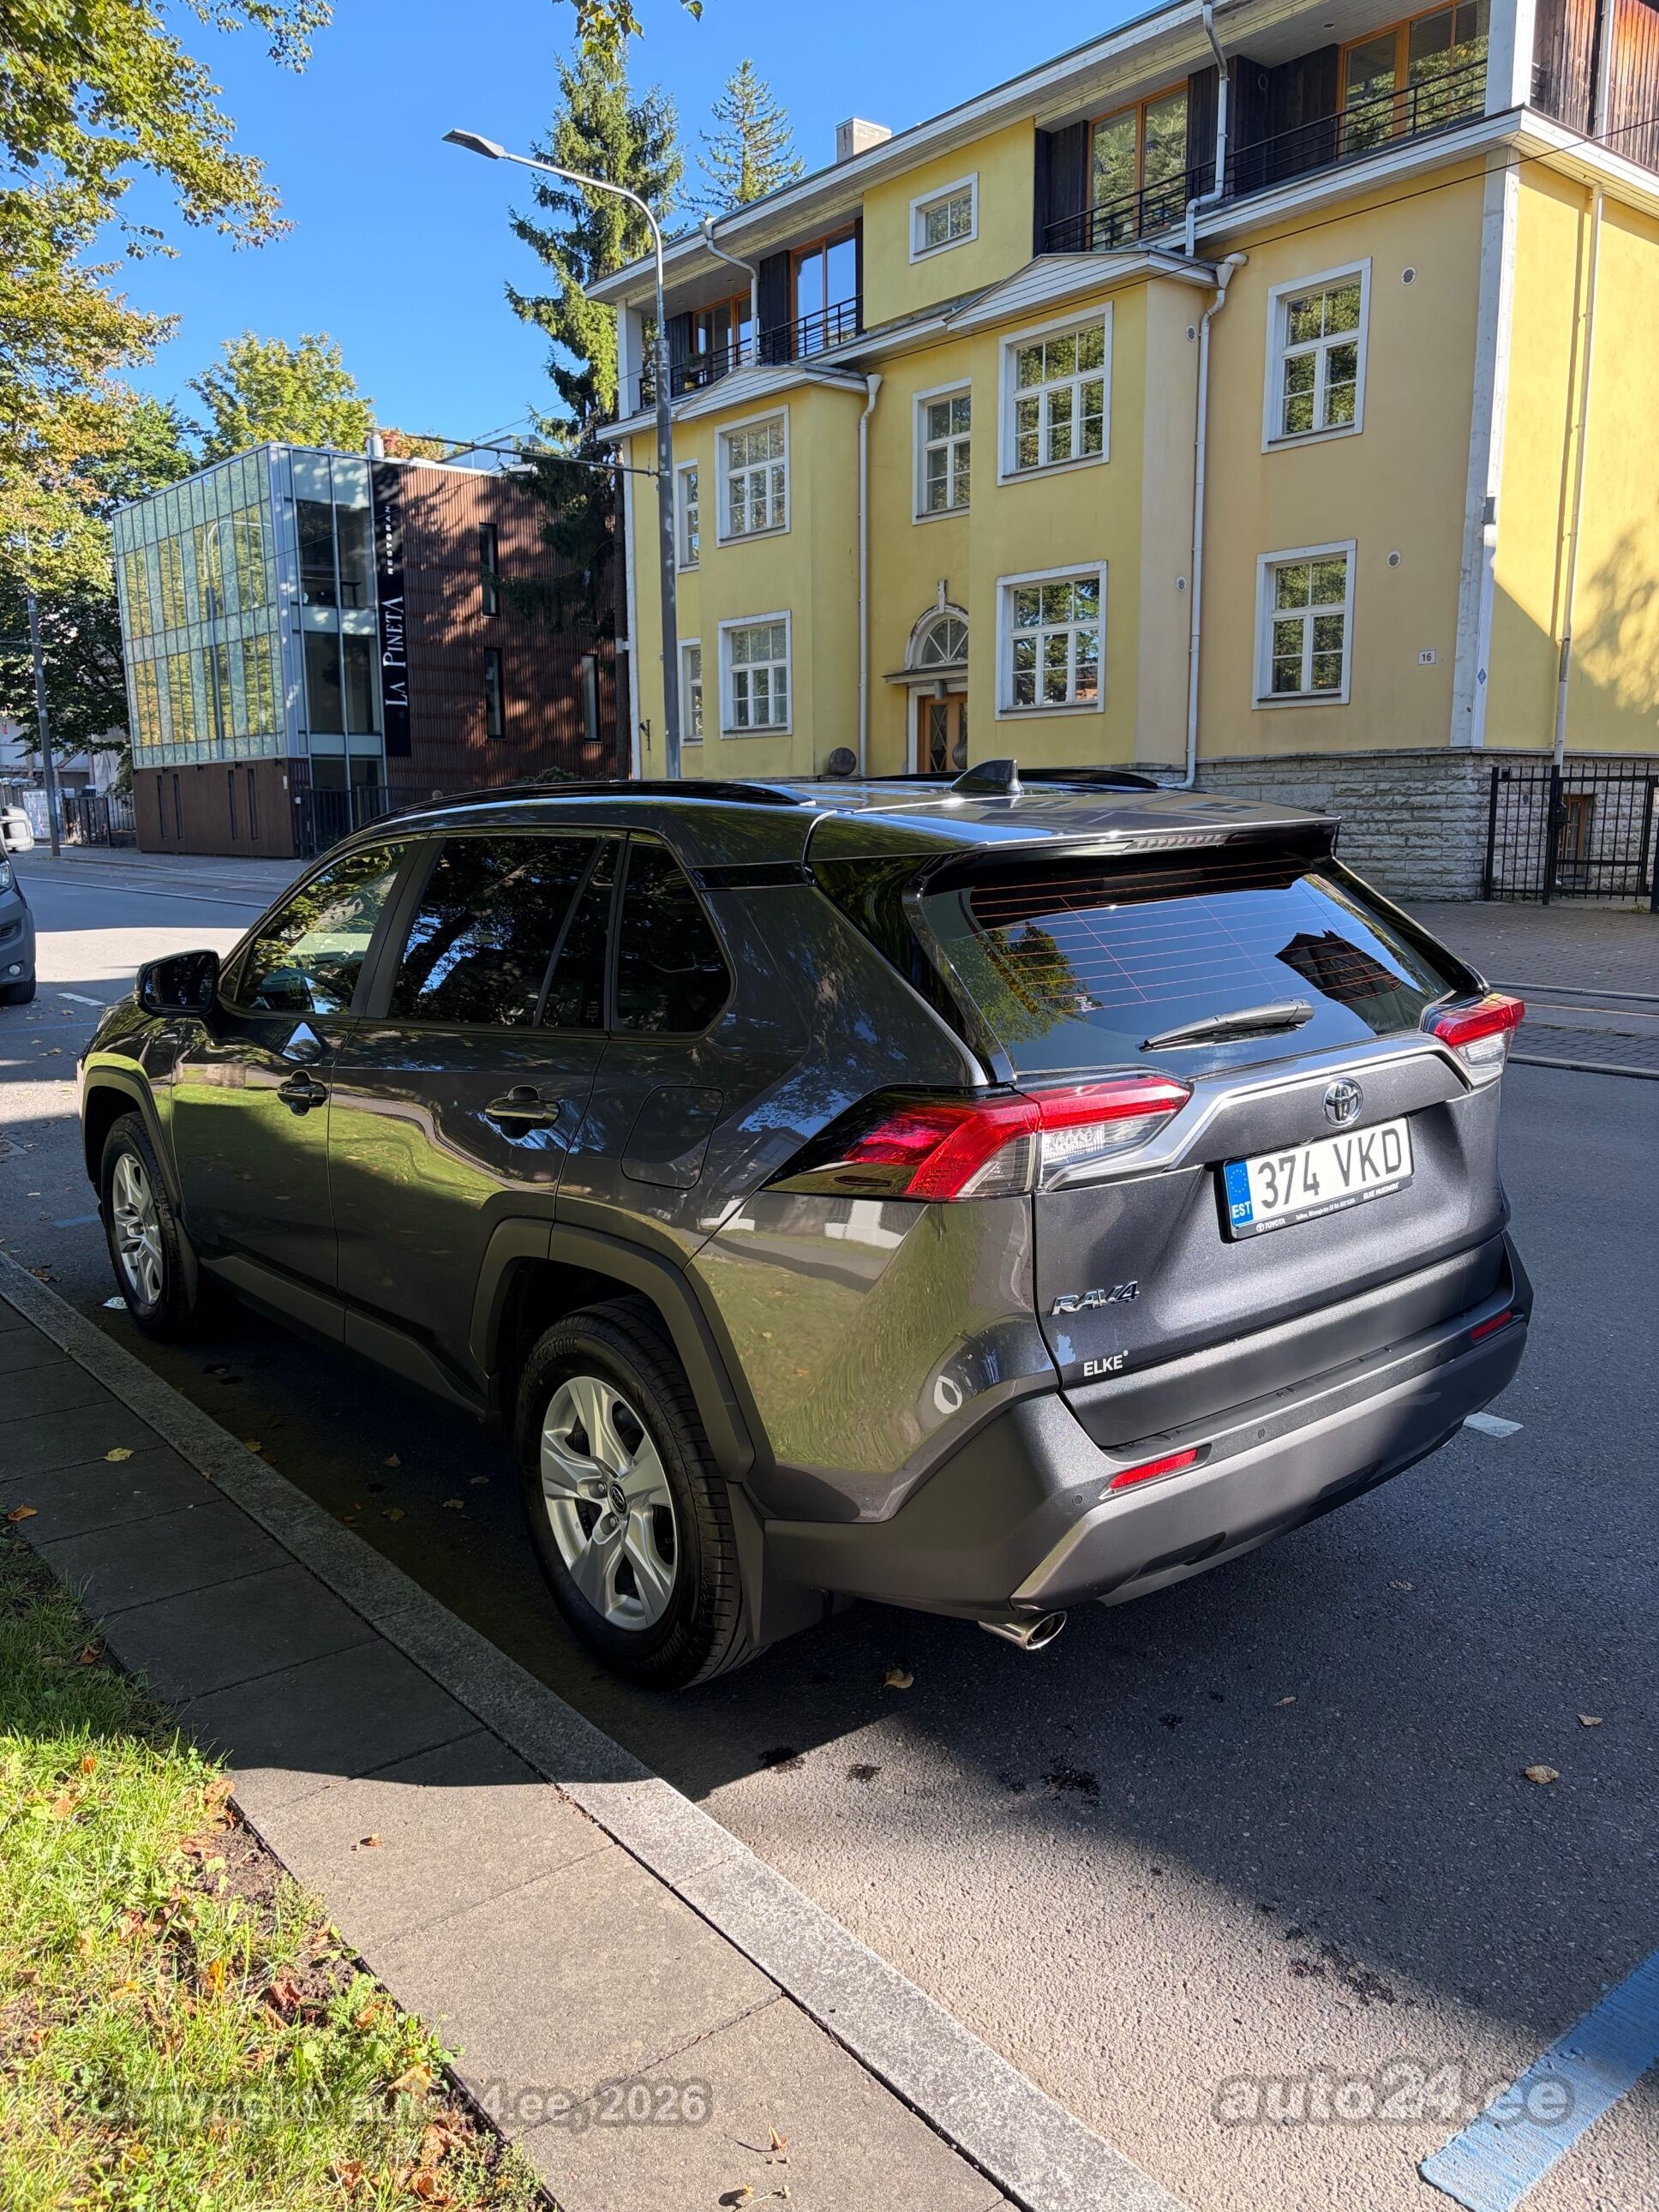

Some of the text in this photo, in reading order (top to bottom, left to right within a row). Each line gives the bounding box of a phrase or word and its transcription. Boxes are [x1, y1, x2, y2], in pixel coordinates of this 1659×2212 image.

[385, 506, 393, 575] RESTORAN
[380, 596, 408, 706] LA PINETA
[1422, 653, 1432, 662] 16
[1258, 1127, 1402, 1209] 374 VKD
[1231, 1201, 1251, 1219] EST
[1264, 1218, 1285, 1230] TOYOTA
[1051, 1280, 1140, 1316] RAV4
[1083, 1354, 1123, 1377] ELKE
